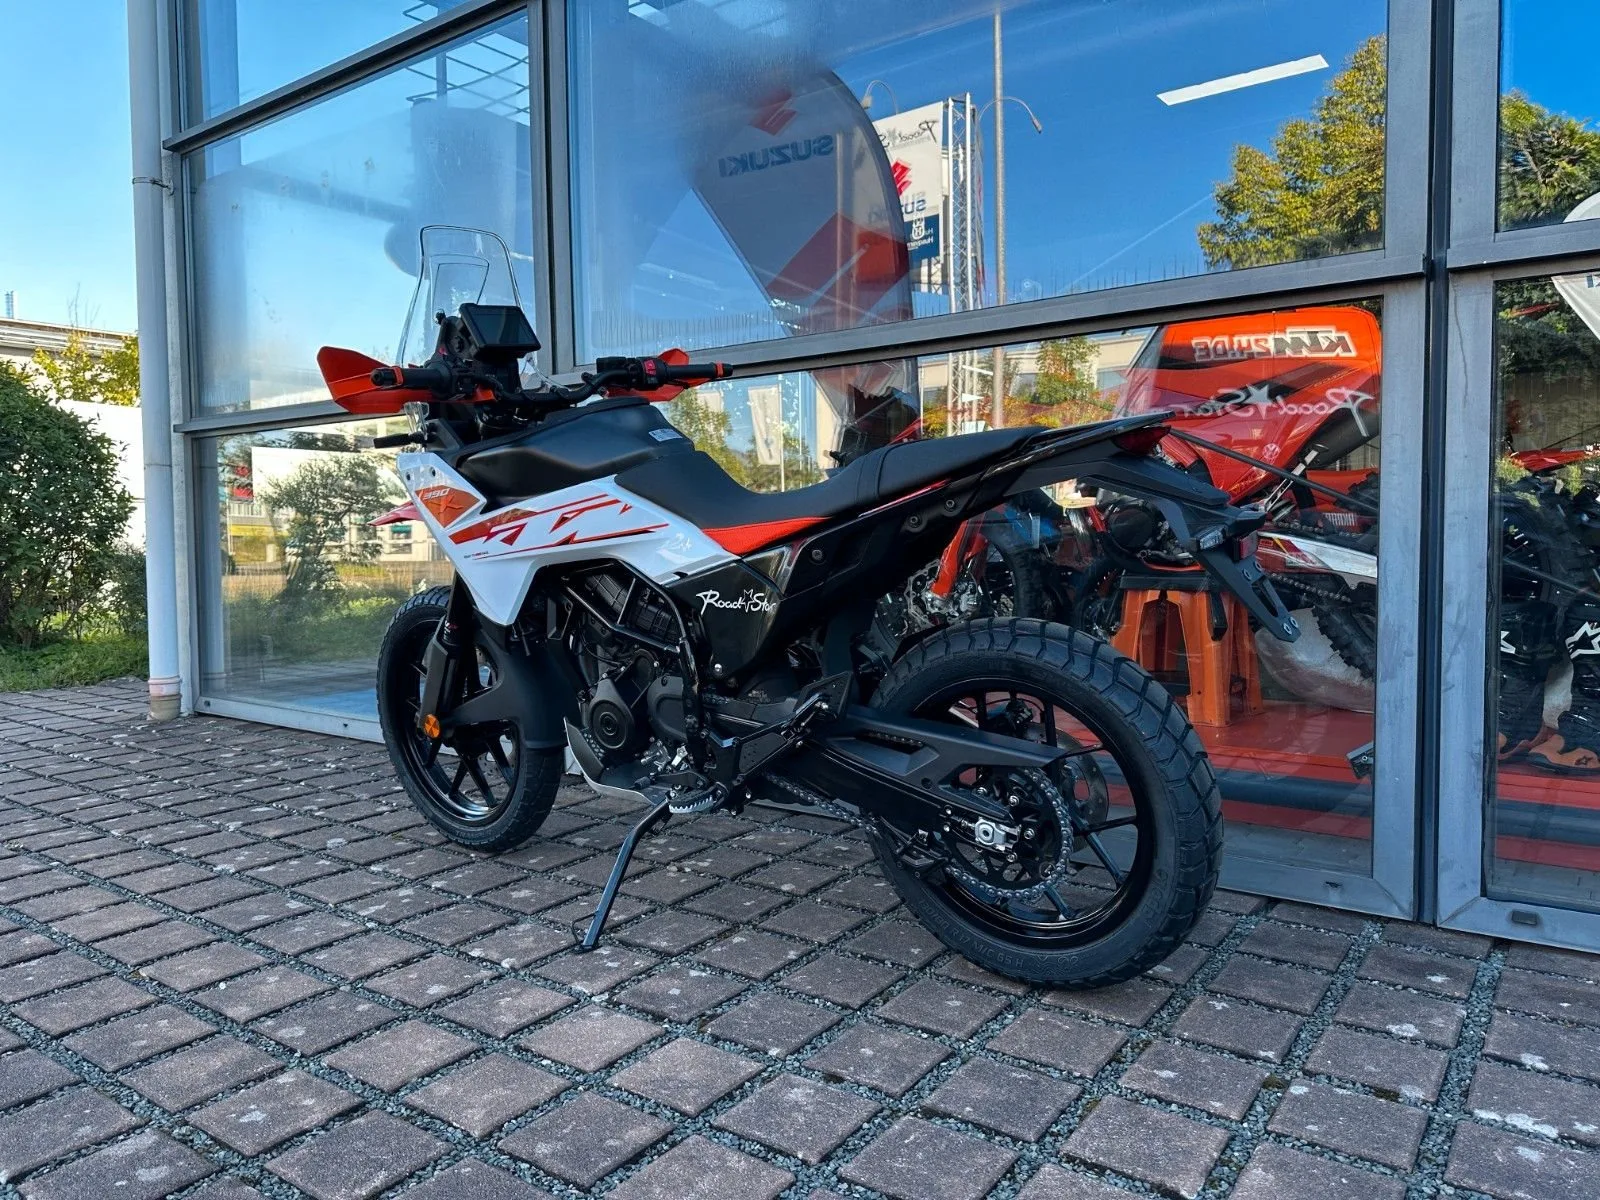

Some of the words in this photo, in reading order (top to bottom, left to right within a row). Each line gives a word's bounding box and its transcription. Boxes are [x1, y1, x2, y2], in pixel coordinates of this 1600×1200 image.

[422, 488, 451, 500] 390
[695, 589, 744, 618] Road
[750, 592, 778, 612] Star
